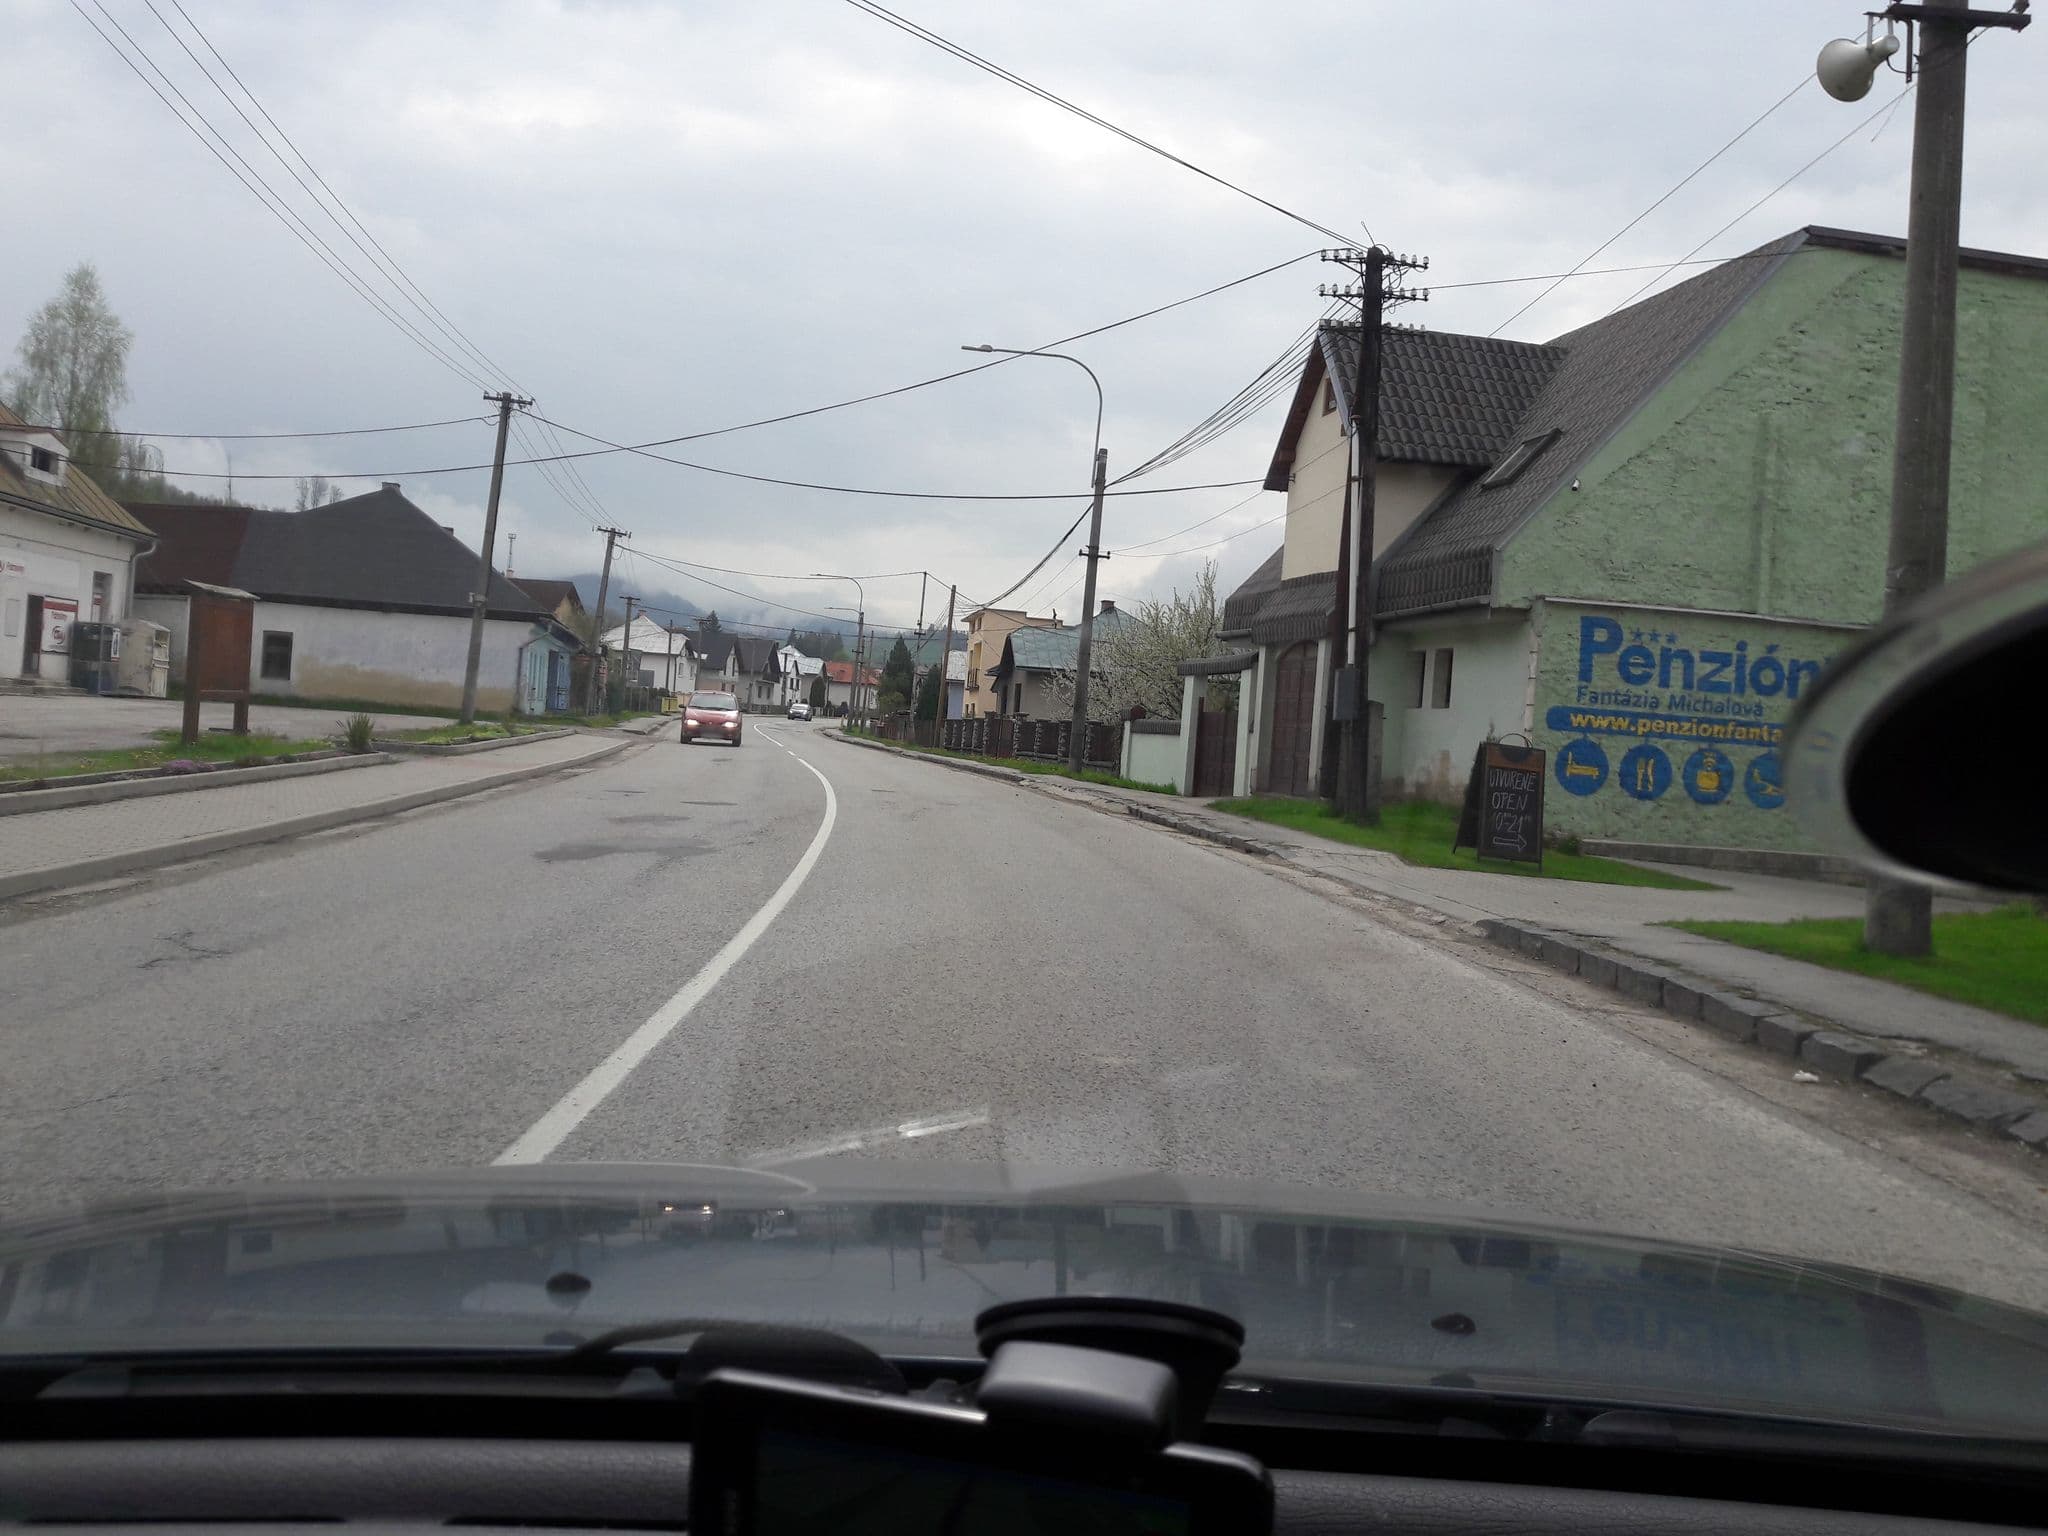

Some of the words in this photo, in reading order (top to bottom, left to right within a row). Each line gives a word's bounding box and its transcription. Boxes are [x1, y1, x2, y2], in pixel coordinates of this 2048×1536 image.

[1578, 616, 1821, 698] Penzión
[1576, 686, 1660, 710] Fantázia
[1569, 711, 1785, 742] www.penzionfanta
[1491, 791, 1528, 811] OPEN
